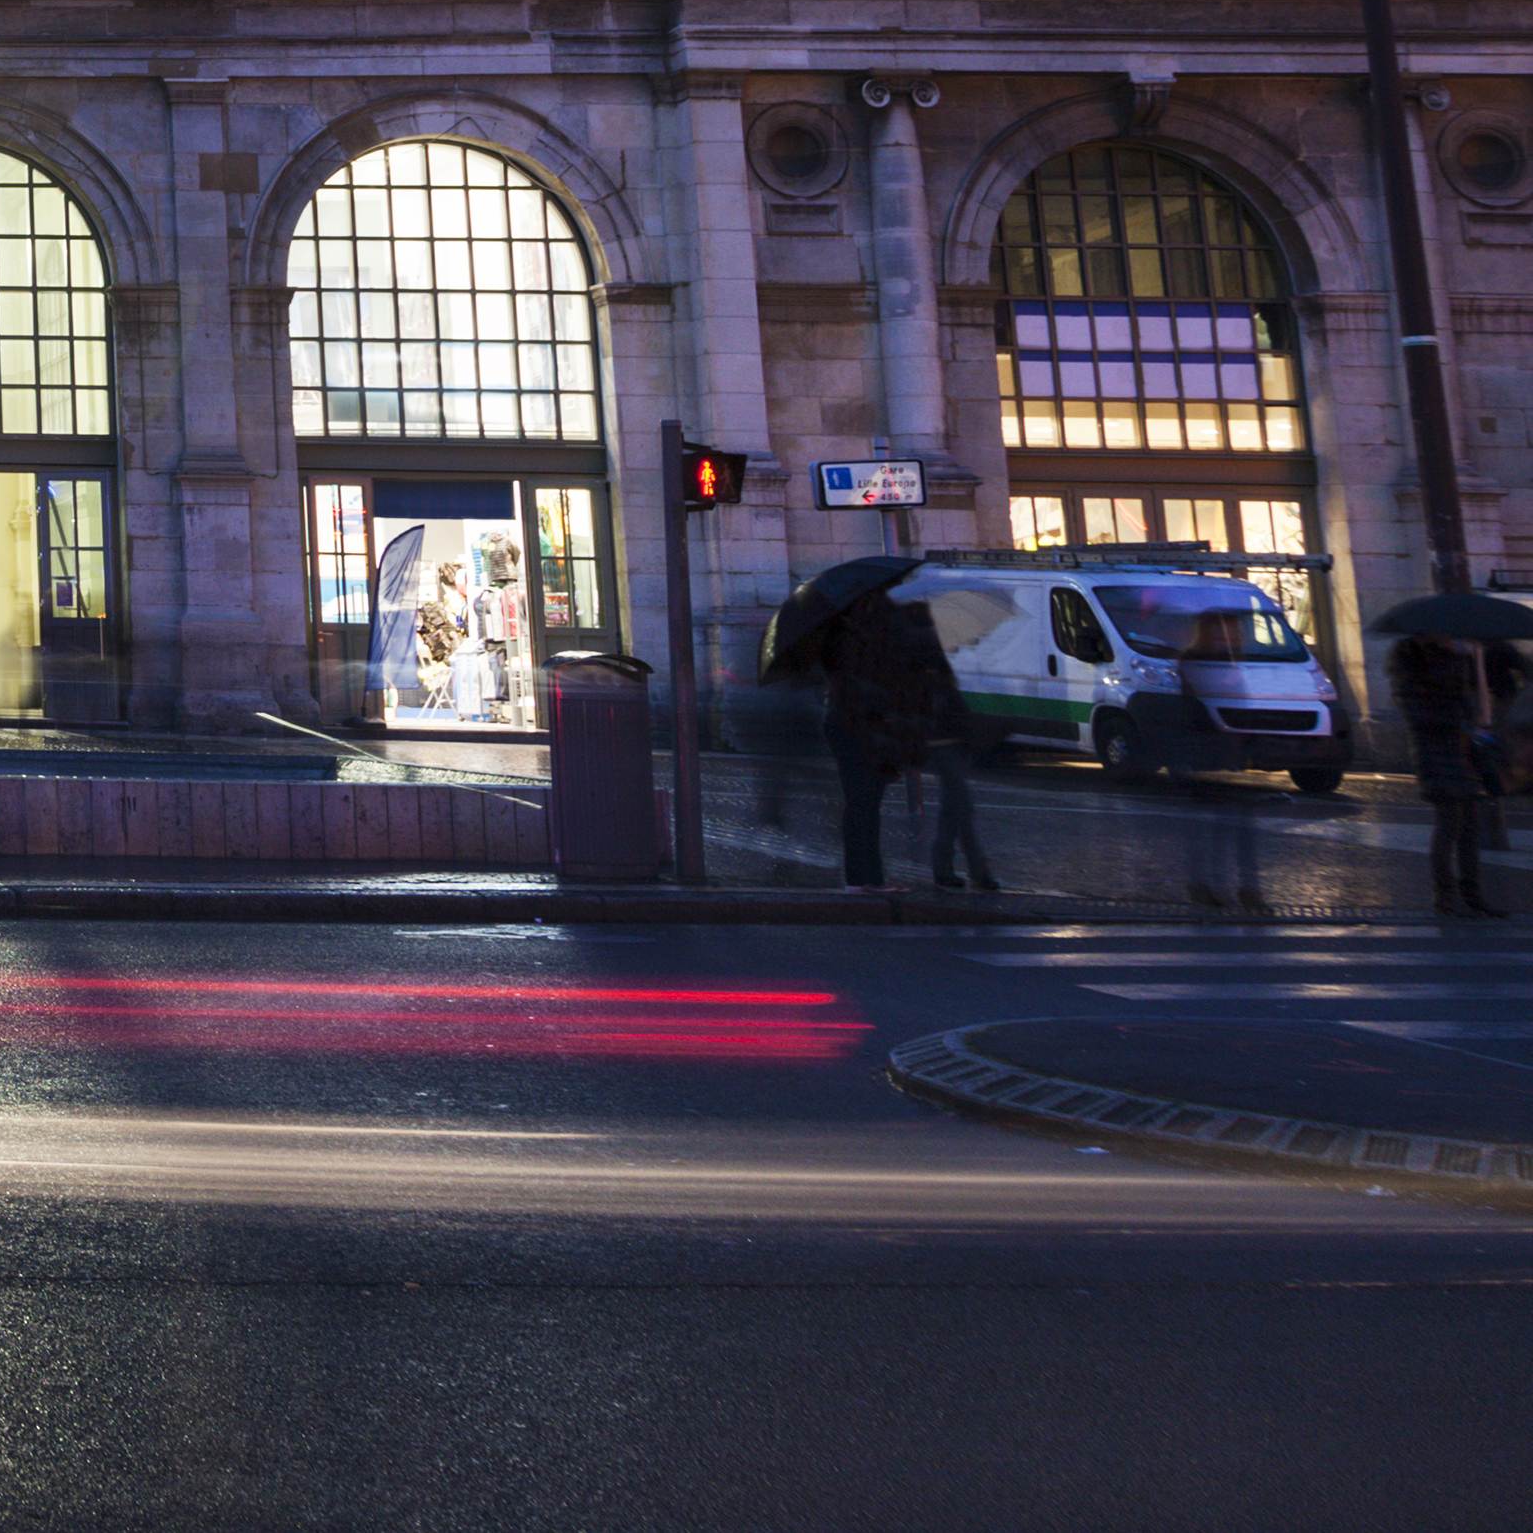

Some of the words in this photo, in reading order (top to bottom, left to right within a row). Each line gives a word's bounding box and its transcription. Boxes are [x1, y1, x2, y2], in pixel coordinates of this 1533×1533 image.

[880, 465, 905, 474] Gare
[857, 479, 879, 488] Lille
[882, 478, 917, 489] Europe
[880, 493, 900, 501] 450
